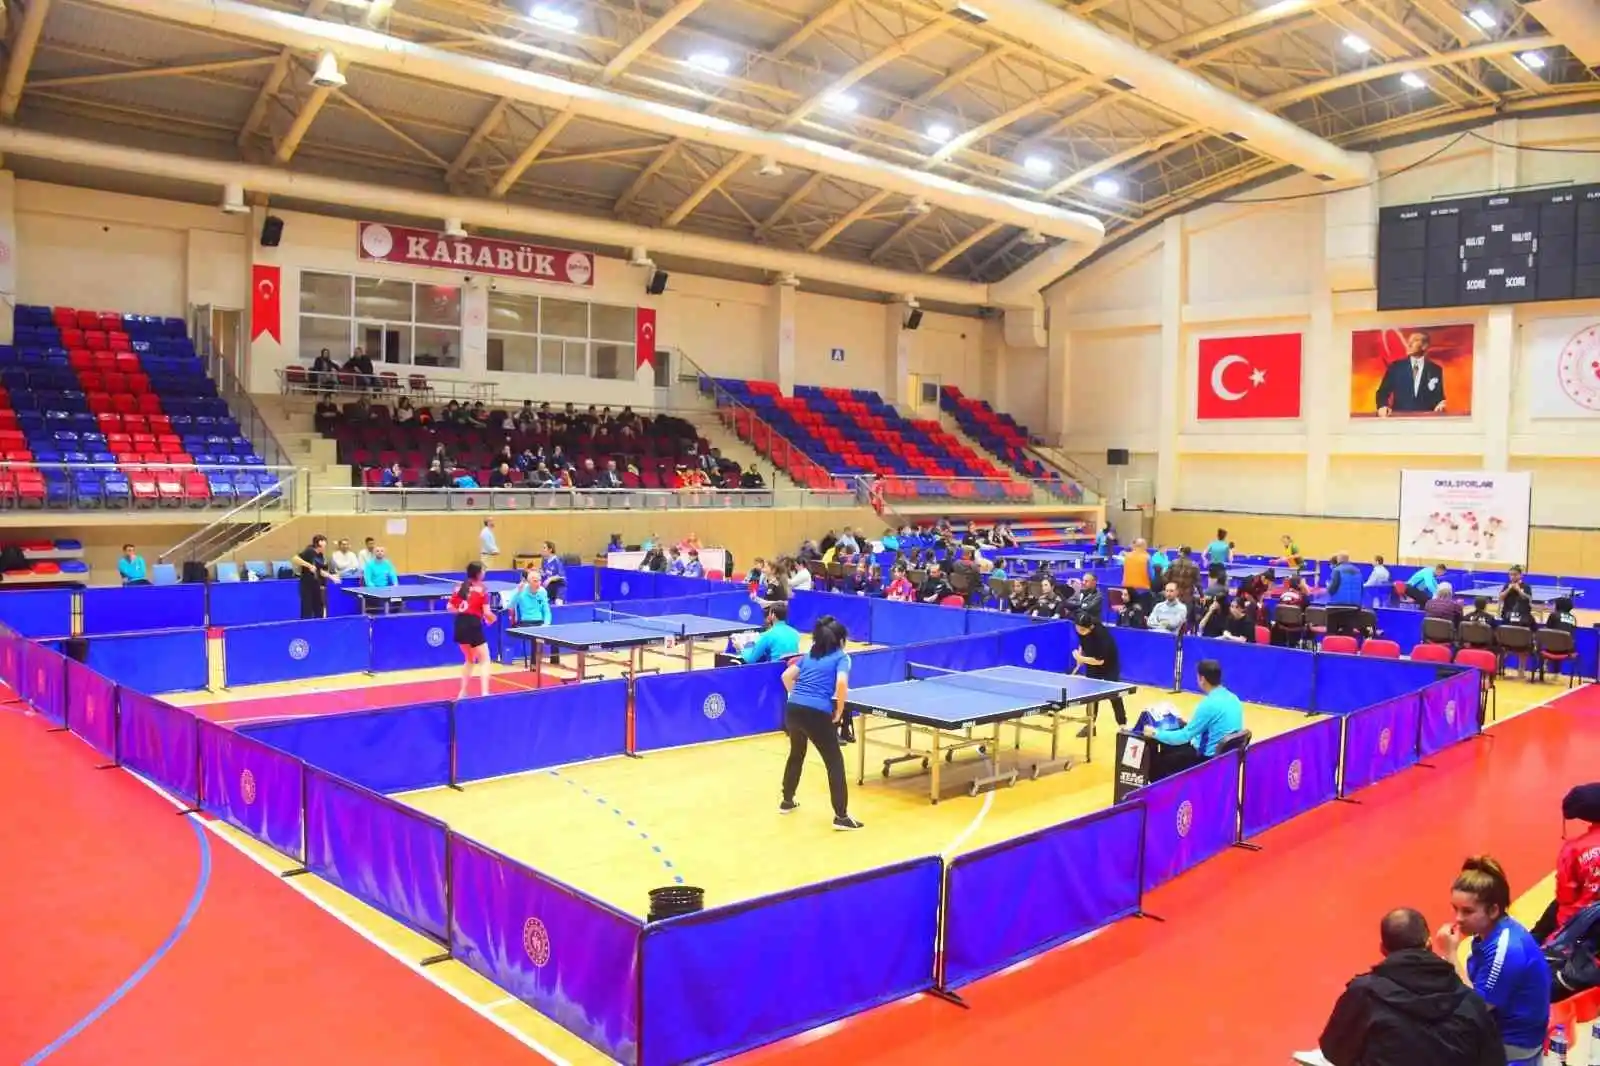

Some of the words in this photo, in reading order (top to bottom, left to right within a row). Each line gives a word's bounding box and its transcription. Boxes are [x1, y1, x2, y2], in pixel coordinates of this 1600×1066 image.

[406, 235, 556, 277] KARABÜK
[1505, 276, 1526, 287] SCORE
[1130, 744, 1139, 759] 1
